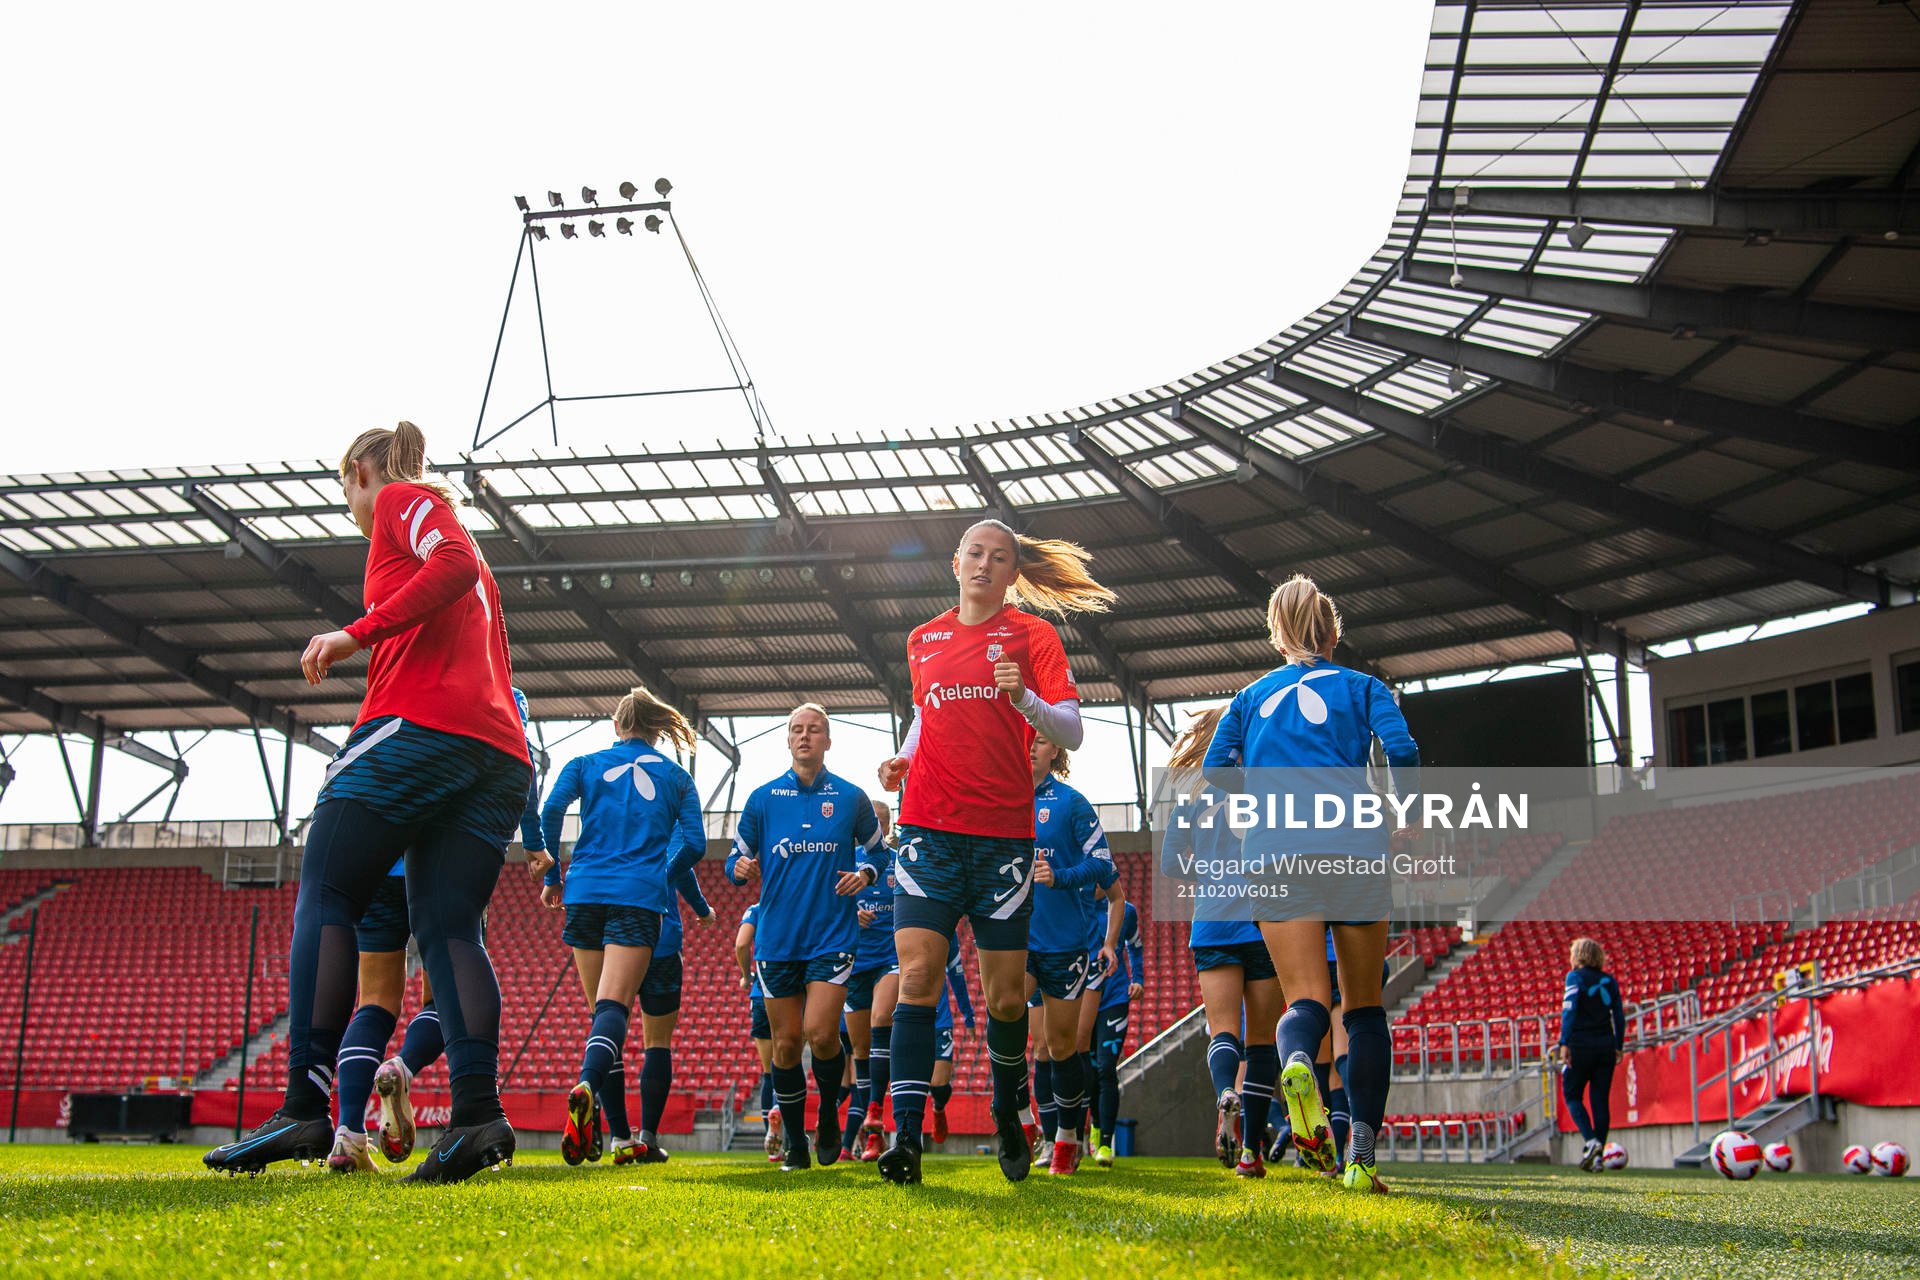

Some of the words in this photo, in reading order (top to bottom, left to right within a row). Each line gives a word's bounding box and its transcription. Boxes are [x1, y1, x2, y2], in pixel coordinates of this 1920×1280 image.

[922, 631, 943, 644] KIWI
[939, 683, 1000, 701] telenor
[771, 788, 790, 797] KIWI
[788, 840, 838, 853] telenor
